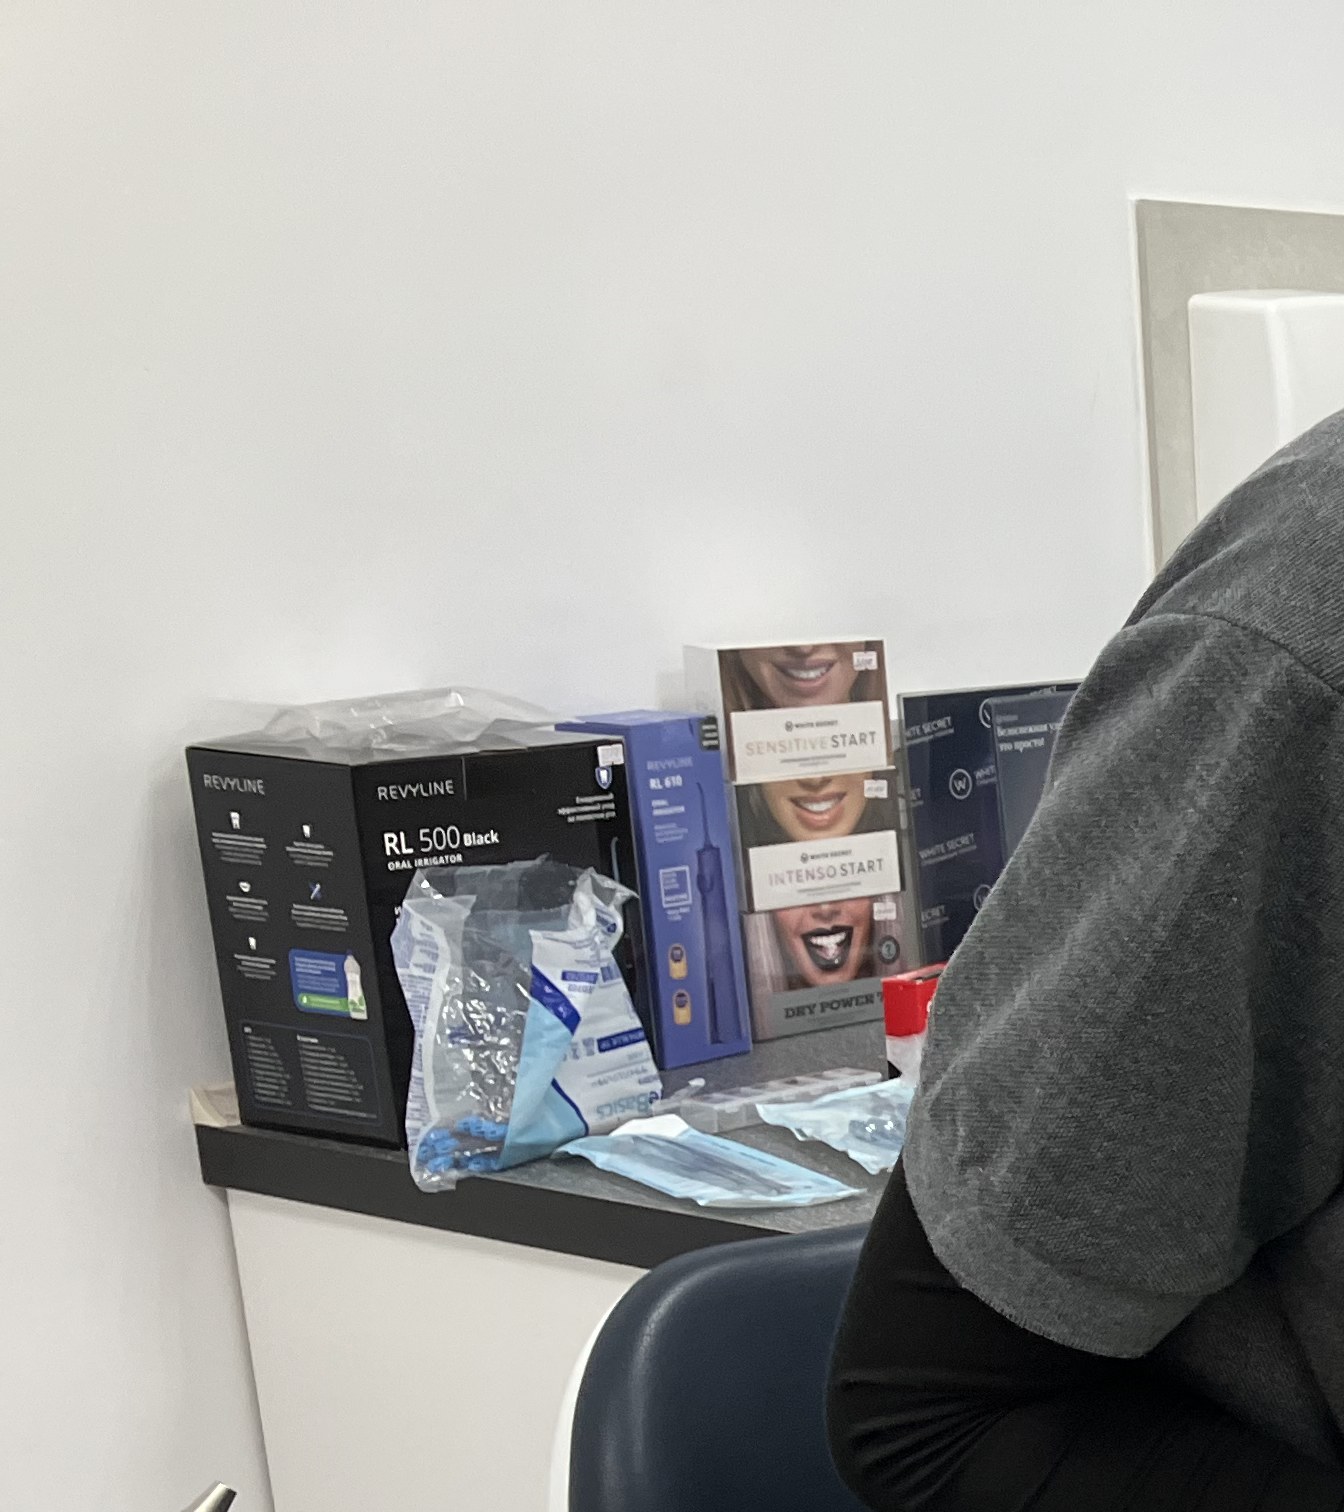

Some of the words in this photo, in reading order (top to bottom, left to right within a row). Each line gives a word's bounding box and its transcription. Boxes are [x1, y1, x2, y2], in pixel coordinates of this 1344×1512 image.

[744, 736, 829, 757] SENSITIVE
[831, 731, 877, 749] START
[203, 773, 266, 796] REVYLINE
[377, 779, 455, 801] REVYLINE
[649, 777, 663, 790] RL
[383, 831, 414, 856] RL
[419, 825, 461, 852] 500
[463, 829, 500, 848] Black
[387, 858, 413, 871] ORAL
[413, 853, 464, 869] IRRIGATOR
[768, 865, 837, 887] INTENSO
[840, 857, 884, 877] START
[784, 1002, 817, 1019] DRY
[819, 991, 876, 1014] POWER
